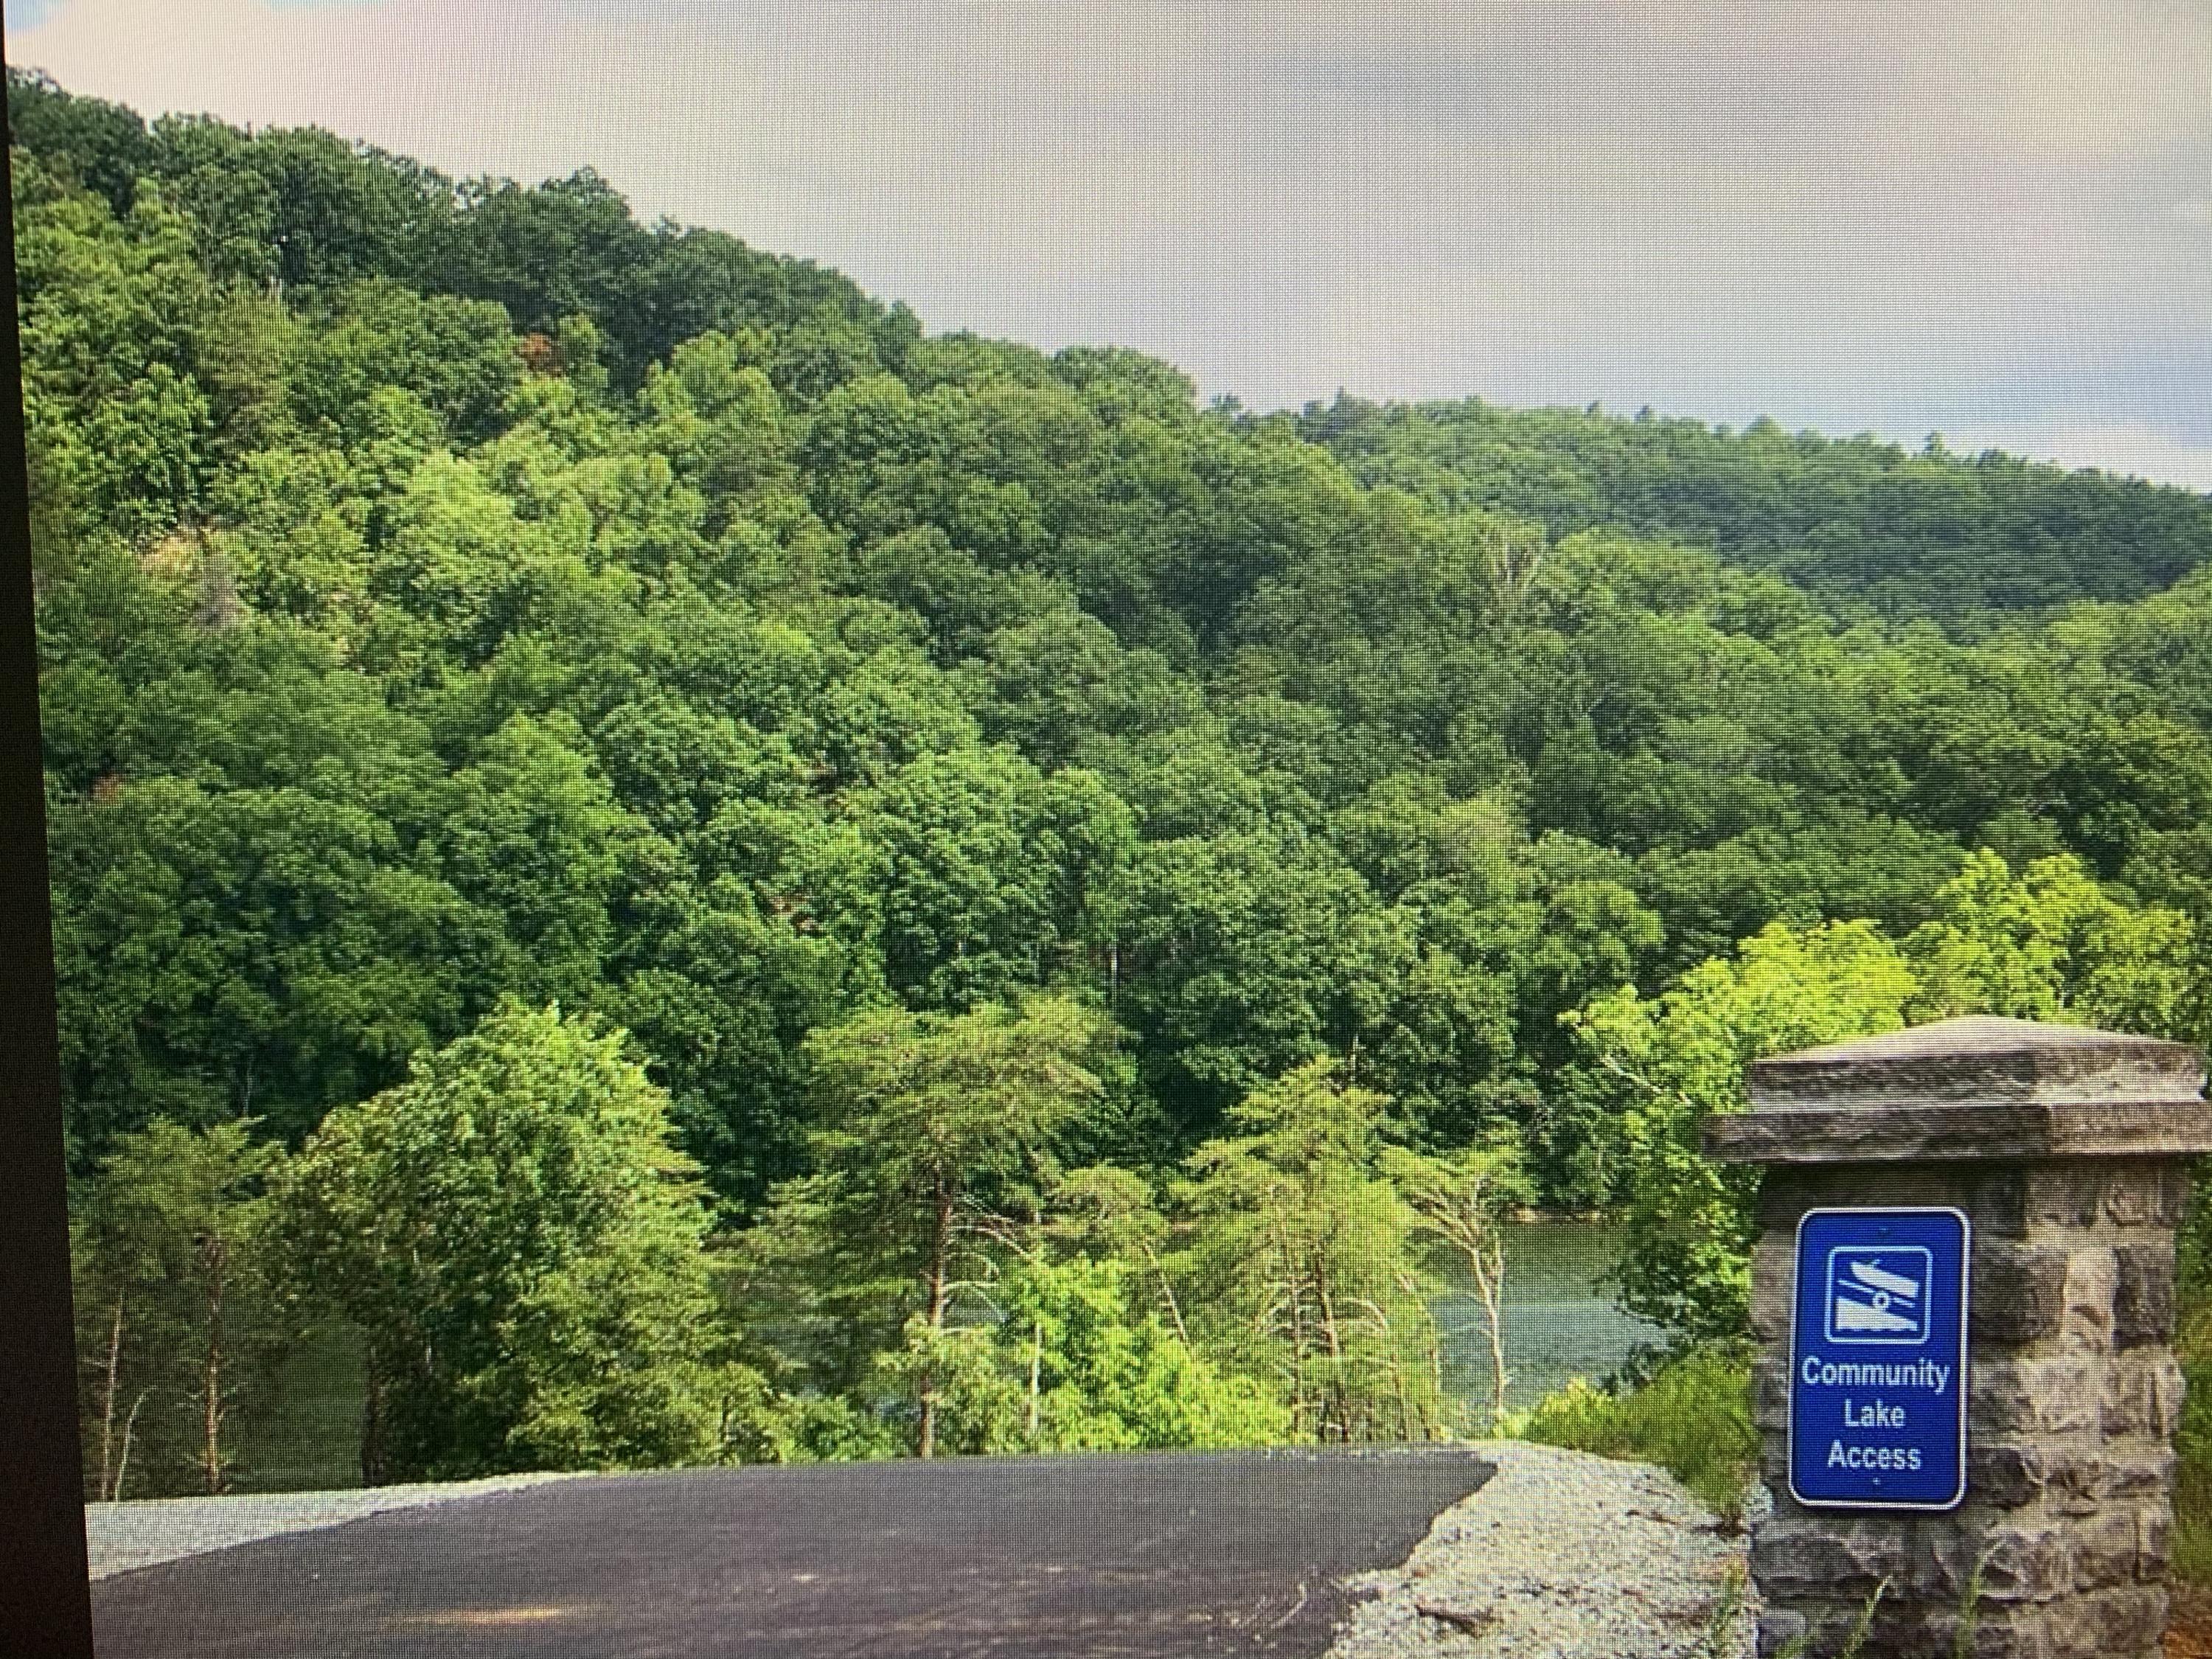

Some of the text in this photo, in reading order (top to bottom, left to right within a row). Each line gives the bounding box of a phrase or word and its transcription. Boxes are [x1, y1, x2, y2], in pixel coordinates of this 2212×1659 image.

[1802, 1355, 1950, 1394] Community
[1845, 1399, 1905, 1427] Lake
[1827, 1439, 1921, 1470] Access
